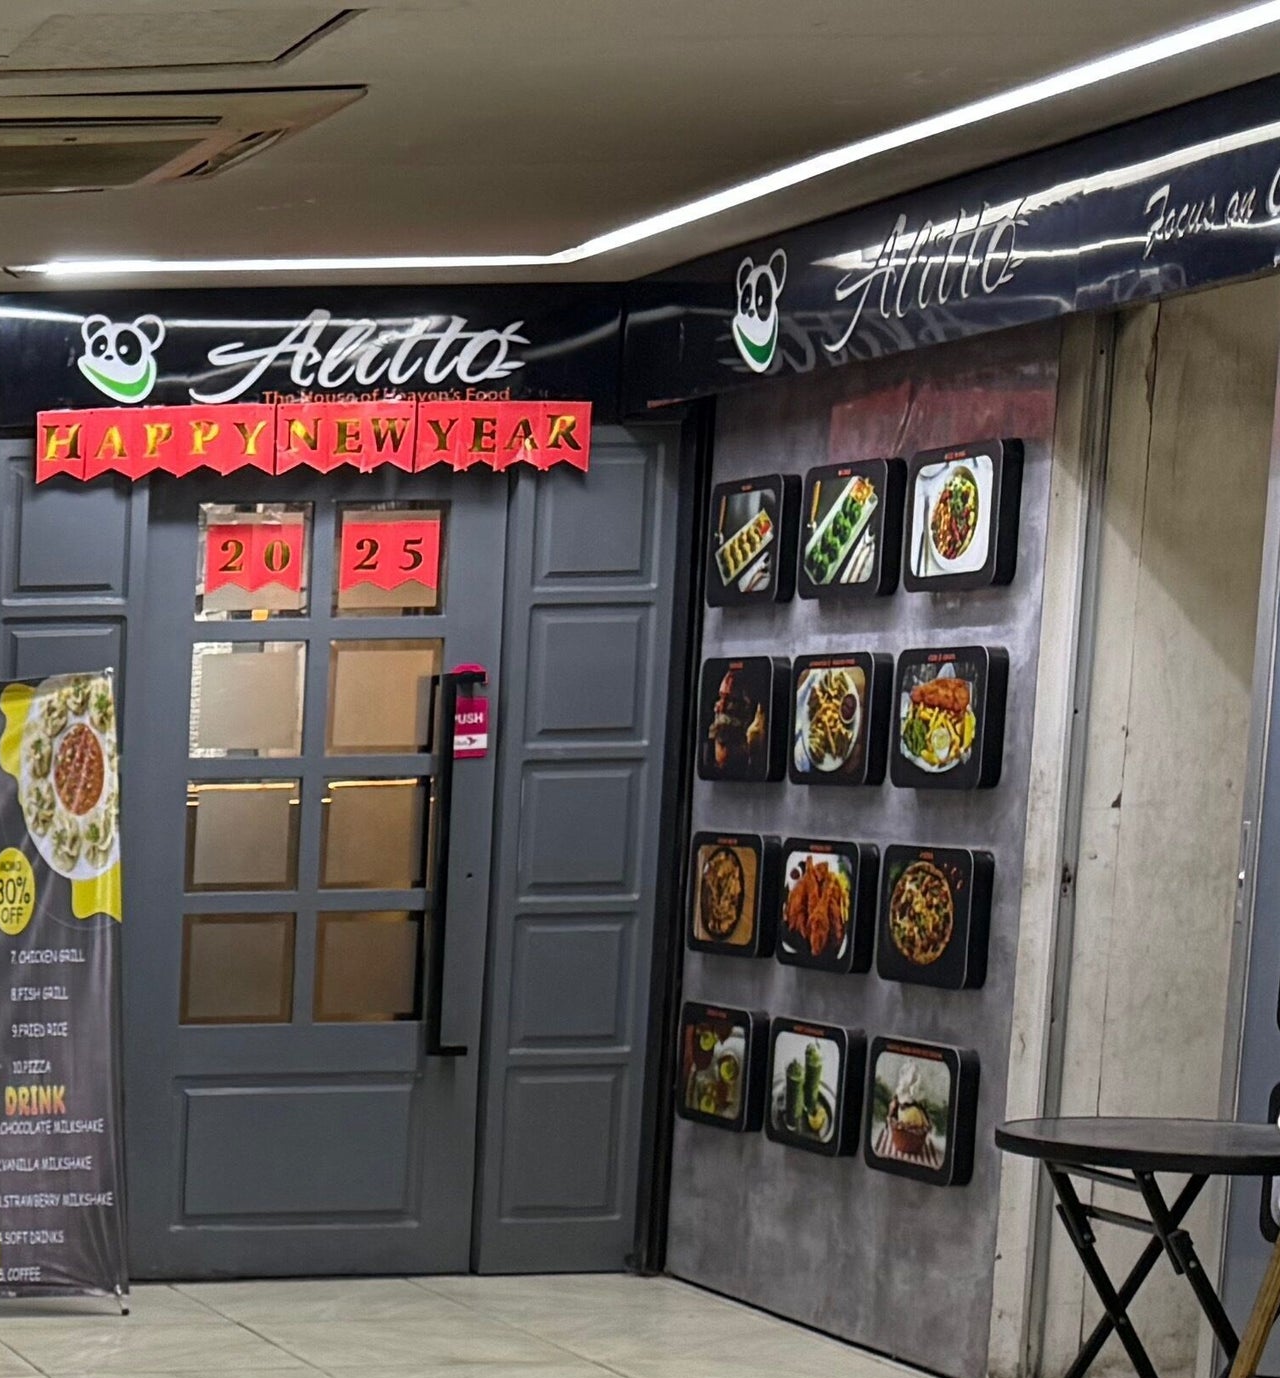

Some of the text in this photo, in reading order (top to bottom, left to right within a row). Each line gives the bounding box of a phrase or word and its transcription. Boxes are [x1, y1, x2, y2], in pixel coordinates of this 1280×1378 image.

[1143, 184, 1216, 260] Focus
[189, 309, 531, 403] Alitto
[361, 390, 379, 402] of
[466, 387, 510, 401] Food
[42, 413, 581, 461] HAPPY NEW YEAR
[219, 537, 424, 572] 20 25
[455, 712, 483, 724] USH
[0, 907, 23, 924] OFF
[59, 949, 85, 962] GRILL
[42, 986, 69, 1000] GRILL
[47, 1022, 68, 1037] RICE
[5, 1085, 66, 1116] DRINK
[53, 1118, 104, 1134] MILKSHAKE
[41, 1156, 92, 1171] MILKSHAKE
[62, 1191, 113, 1207] MILKSHAKE
[30, 1230, 64, 1244] DRINKS
[7, 1266, 41, 1282] COFFEE
